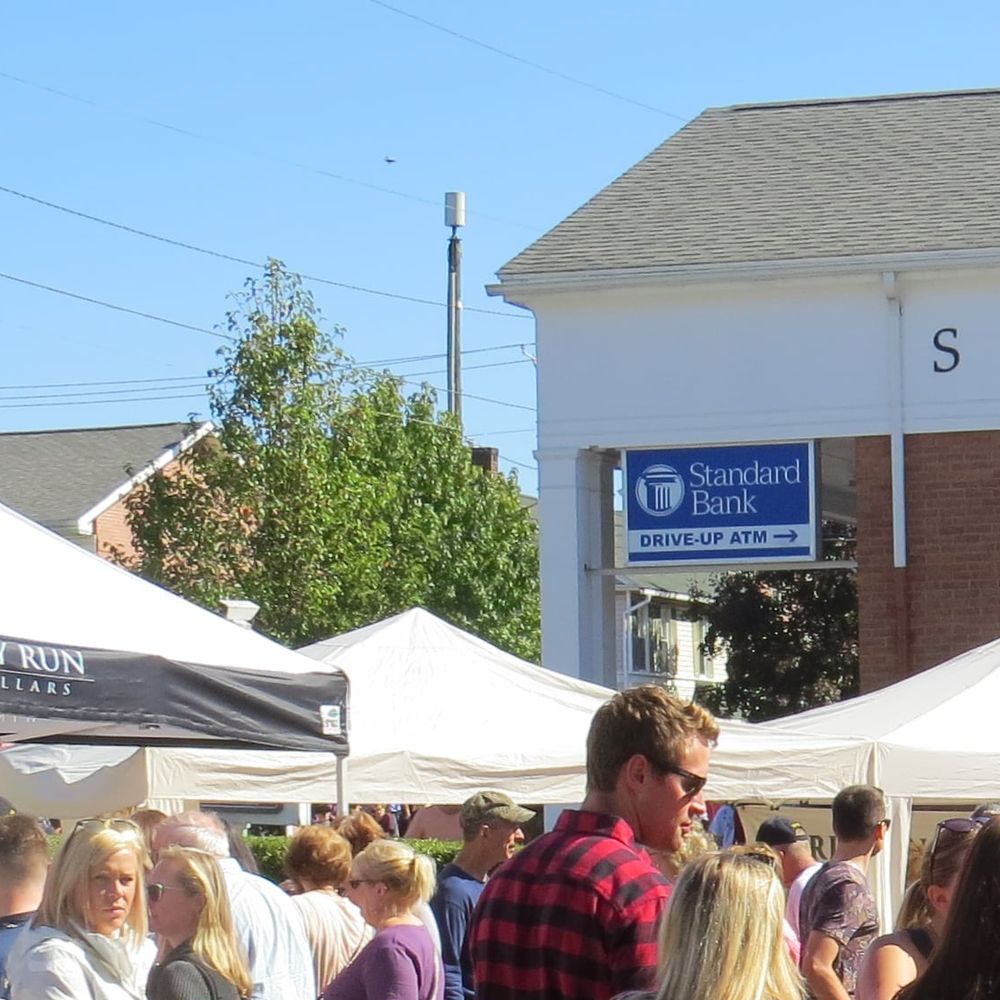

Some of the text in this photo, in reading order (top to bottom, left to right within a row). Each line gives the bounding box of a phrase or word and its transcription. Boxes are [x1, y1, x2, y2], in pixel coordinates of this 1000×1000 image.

[689, 458, 801, 488] Standard
[691, 488, 758, 516] Bank
[640, 530, 767, 548] DRIVE-UP ATM
[18, 643, 86, 675] RUN
